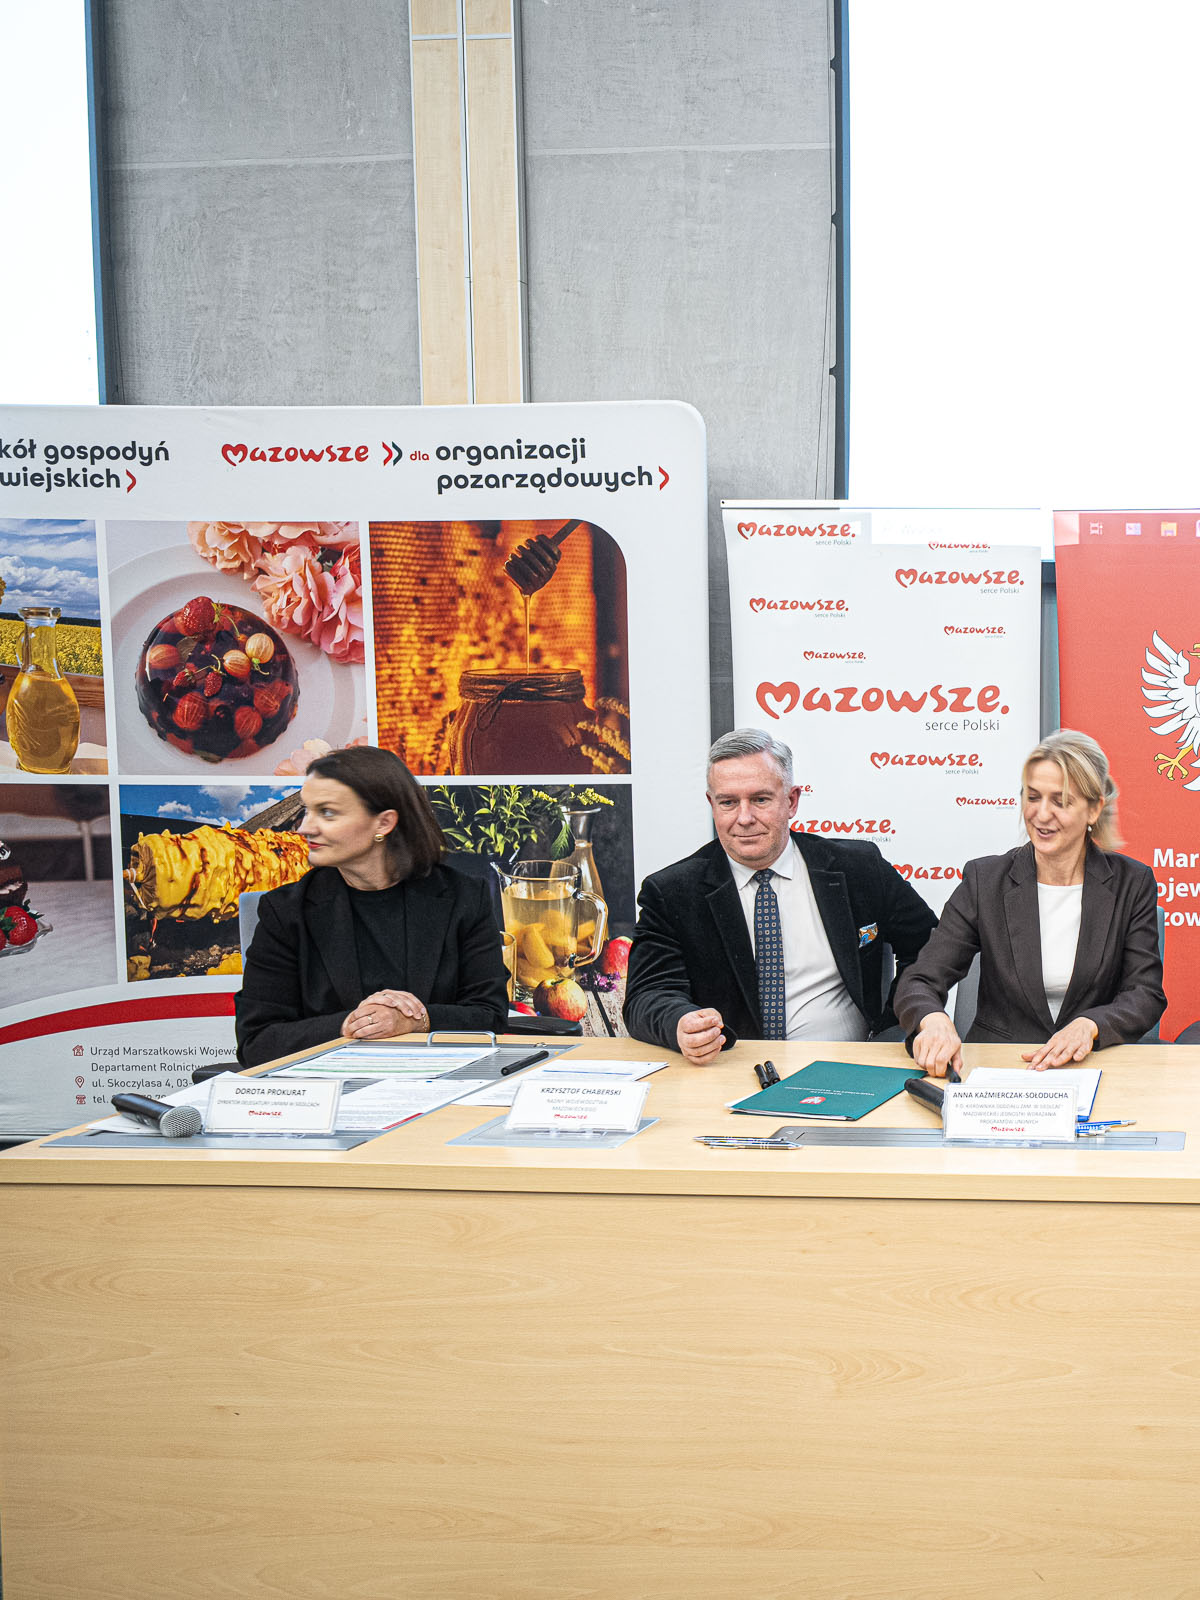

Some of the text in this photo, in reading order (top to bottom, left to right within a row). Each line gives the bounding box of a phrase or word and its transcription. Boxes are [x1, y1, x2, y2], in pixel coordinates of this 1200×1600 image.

[0, 438, 170, 466] kół gospodyń
[221, 437, 587, 467] Mazowsze dla organizacji
[0, 466, 121, 492] wiejskich
[437, 466, 653, 494] pozarządowych
[895, 568, 1025, 589] Mazowsze.
[1000, 586, 1020, 594] Polski
[749, 597, 849, 613] Mazowsze.
[755, 681, 1010, 720] Mazowsze.
[925, 719, 1000, 731] serce Polski
[870, 751, 983, 769] Mazowsze.
[790, 819, 896, 834] azowsze.
[90, 1046, 237, 1057] Urząd Marszałkowski Wojewó
[91, 1063, 157, 1073] Departament
[92, 1079, 194, 1089] ul. Skoczylasa 4, 03-
[92, 1095, 109, 1103] tel.
[581, 1088, 622, 1096] CHABERSKI
